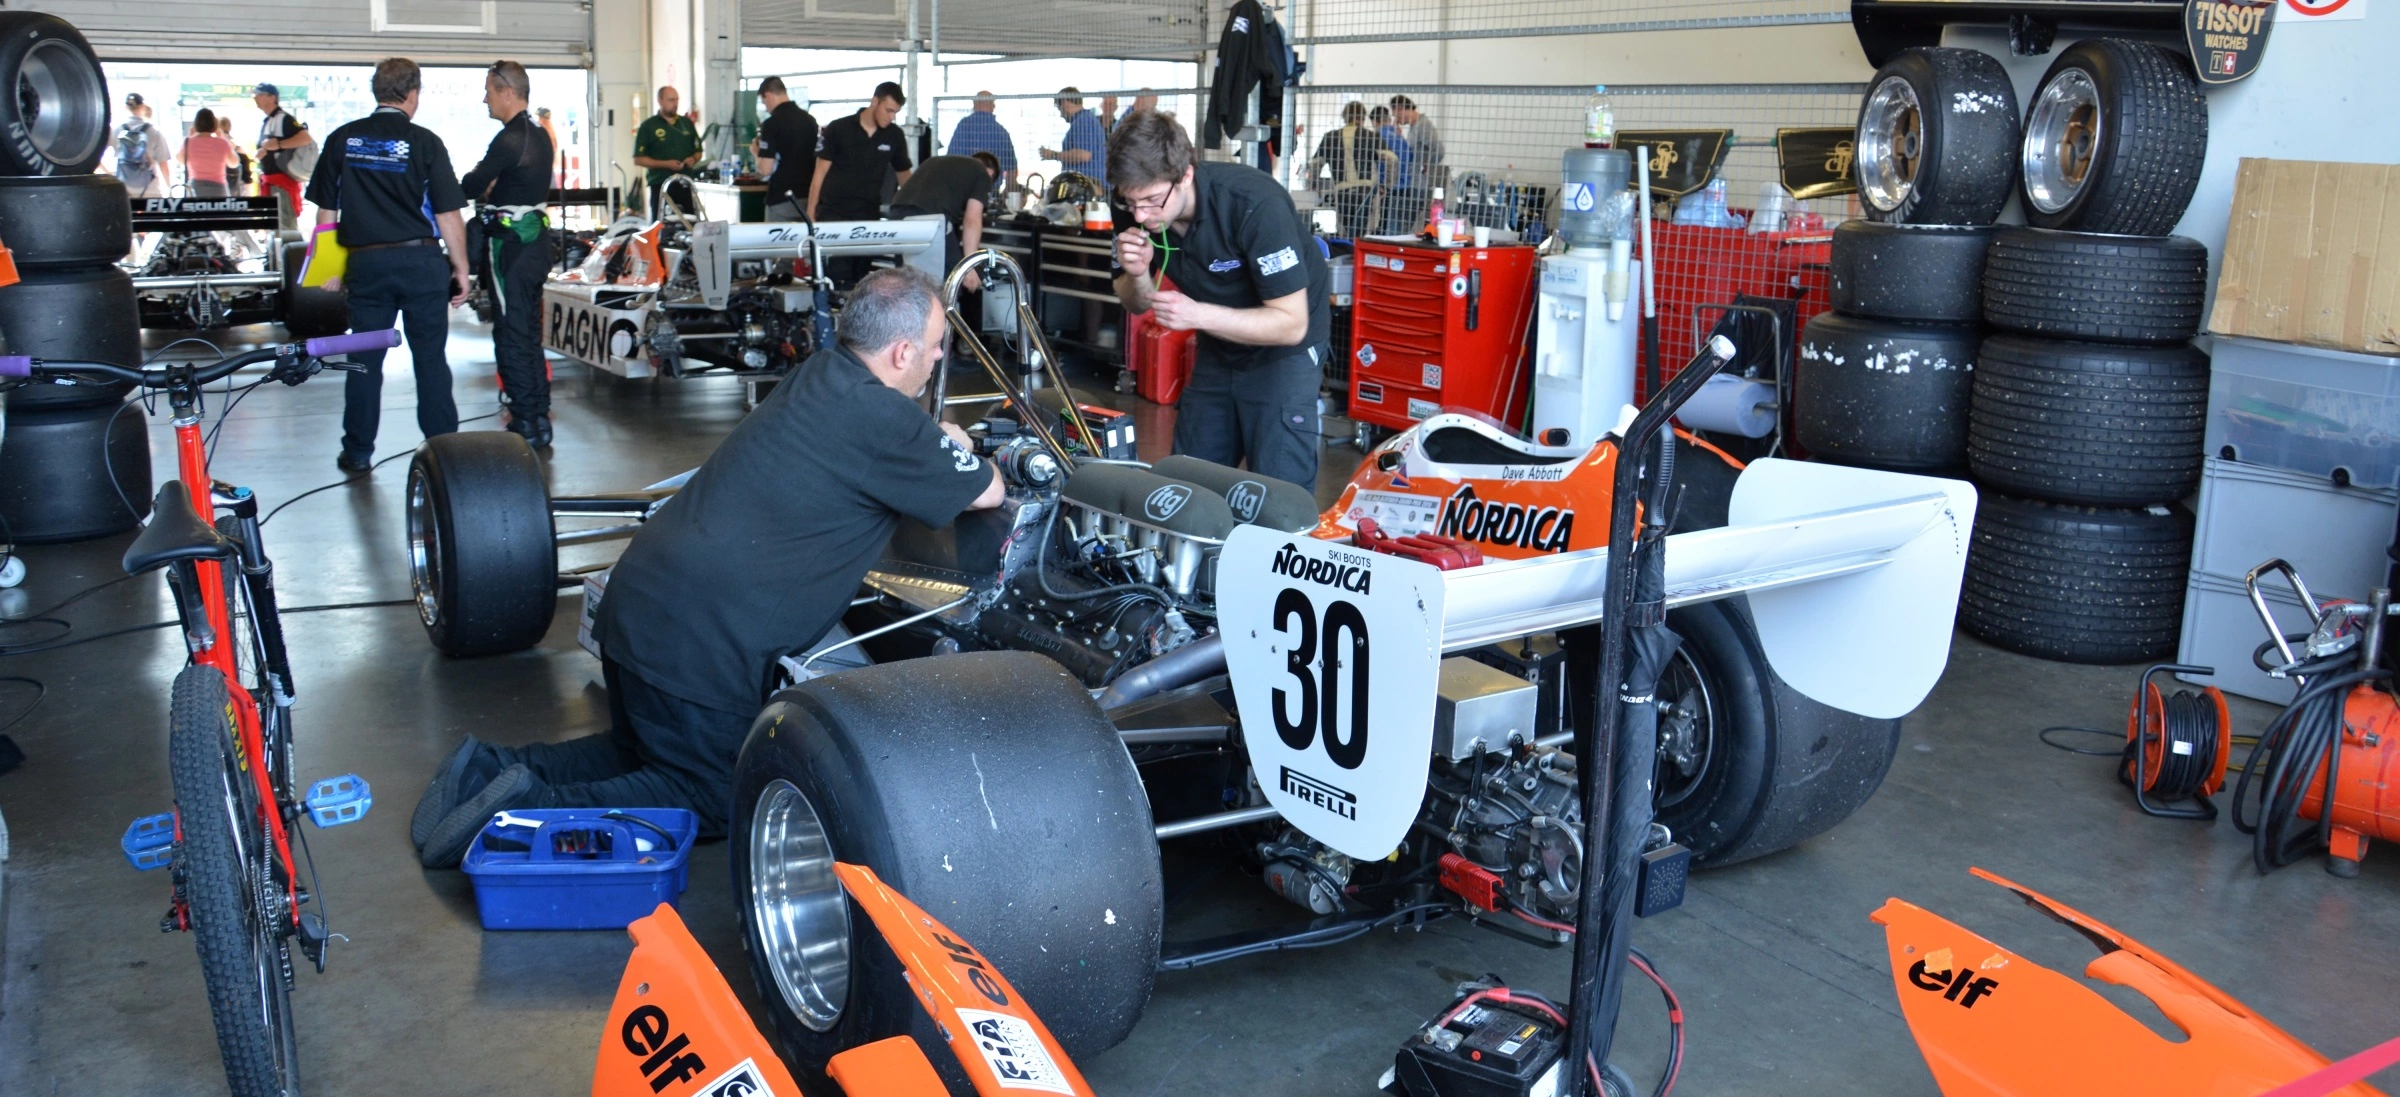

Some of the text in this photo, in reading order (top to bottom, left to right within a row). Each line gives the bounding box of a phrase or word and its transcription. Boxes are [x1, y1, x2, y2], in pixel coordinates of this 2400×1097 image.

[2196, 1, 2266, 35] TISSOT
[2205, 34, 2248, 51] WATCHES
[146, 198, 182, 213] FLY
[769, 228, 798, 242] The
[849, 226, 897, 240] Baron
[1502, 466, 1563, 480] Dave Abbott
[1151, 487, 1183, 516] itg
[1231, 484, 1258, 519] itg
[1437, 484, 1575, 553] NORDICA
[1271, 542, 1371, 596] NORDICA
[1328, 549, 1372, 568] SKI BOOTS
[1271, 587, 1370, 770] 30
[1280, 765, 1357, 821] PIRELLI
[932, 932, 1008, 1007] elf
[1908, 959, 1999, 1009] elf
[621, 1004, 706, 1095] elf
